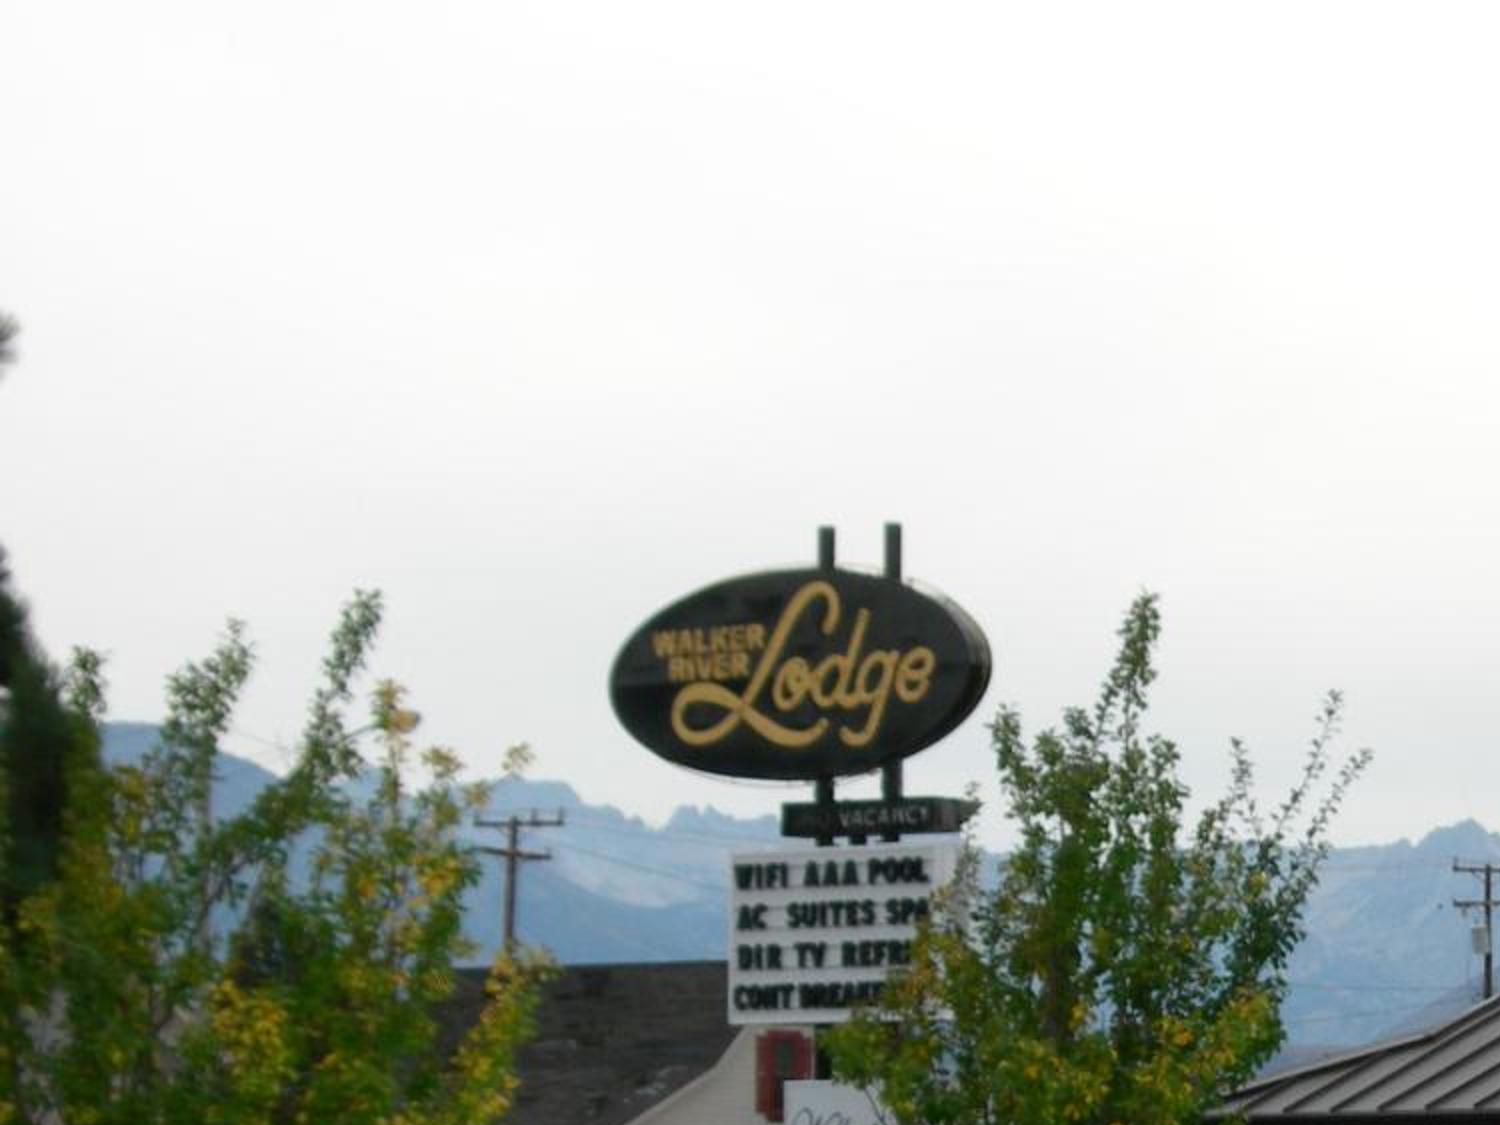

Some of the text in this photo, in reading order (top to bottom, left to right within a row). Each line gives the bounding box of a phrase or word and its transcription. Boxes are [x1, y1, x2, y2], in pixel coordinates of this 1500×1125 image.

[653, 623, 766, 656] WALKER
[669, 653, 750, 682] RIVER
[671, 580, 936, 747] Lodge
[839, 806, 929, 828] VACANCY
[735, 857, 929, 890] WIFI AAA POOL
[738, 904, 767, 930] AC
[787, 900, 876, 928] SUITES
[738, 944, 782, 970] DIR
[795, 942, 826, 968] TV
[734, 985, 795, 1010] CONT
